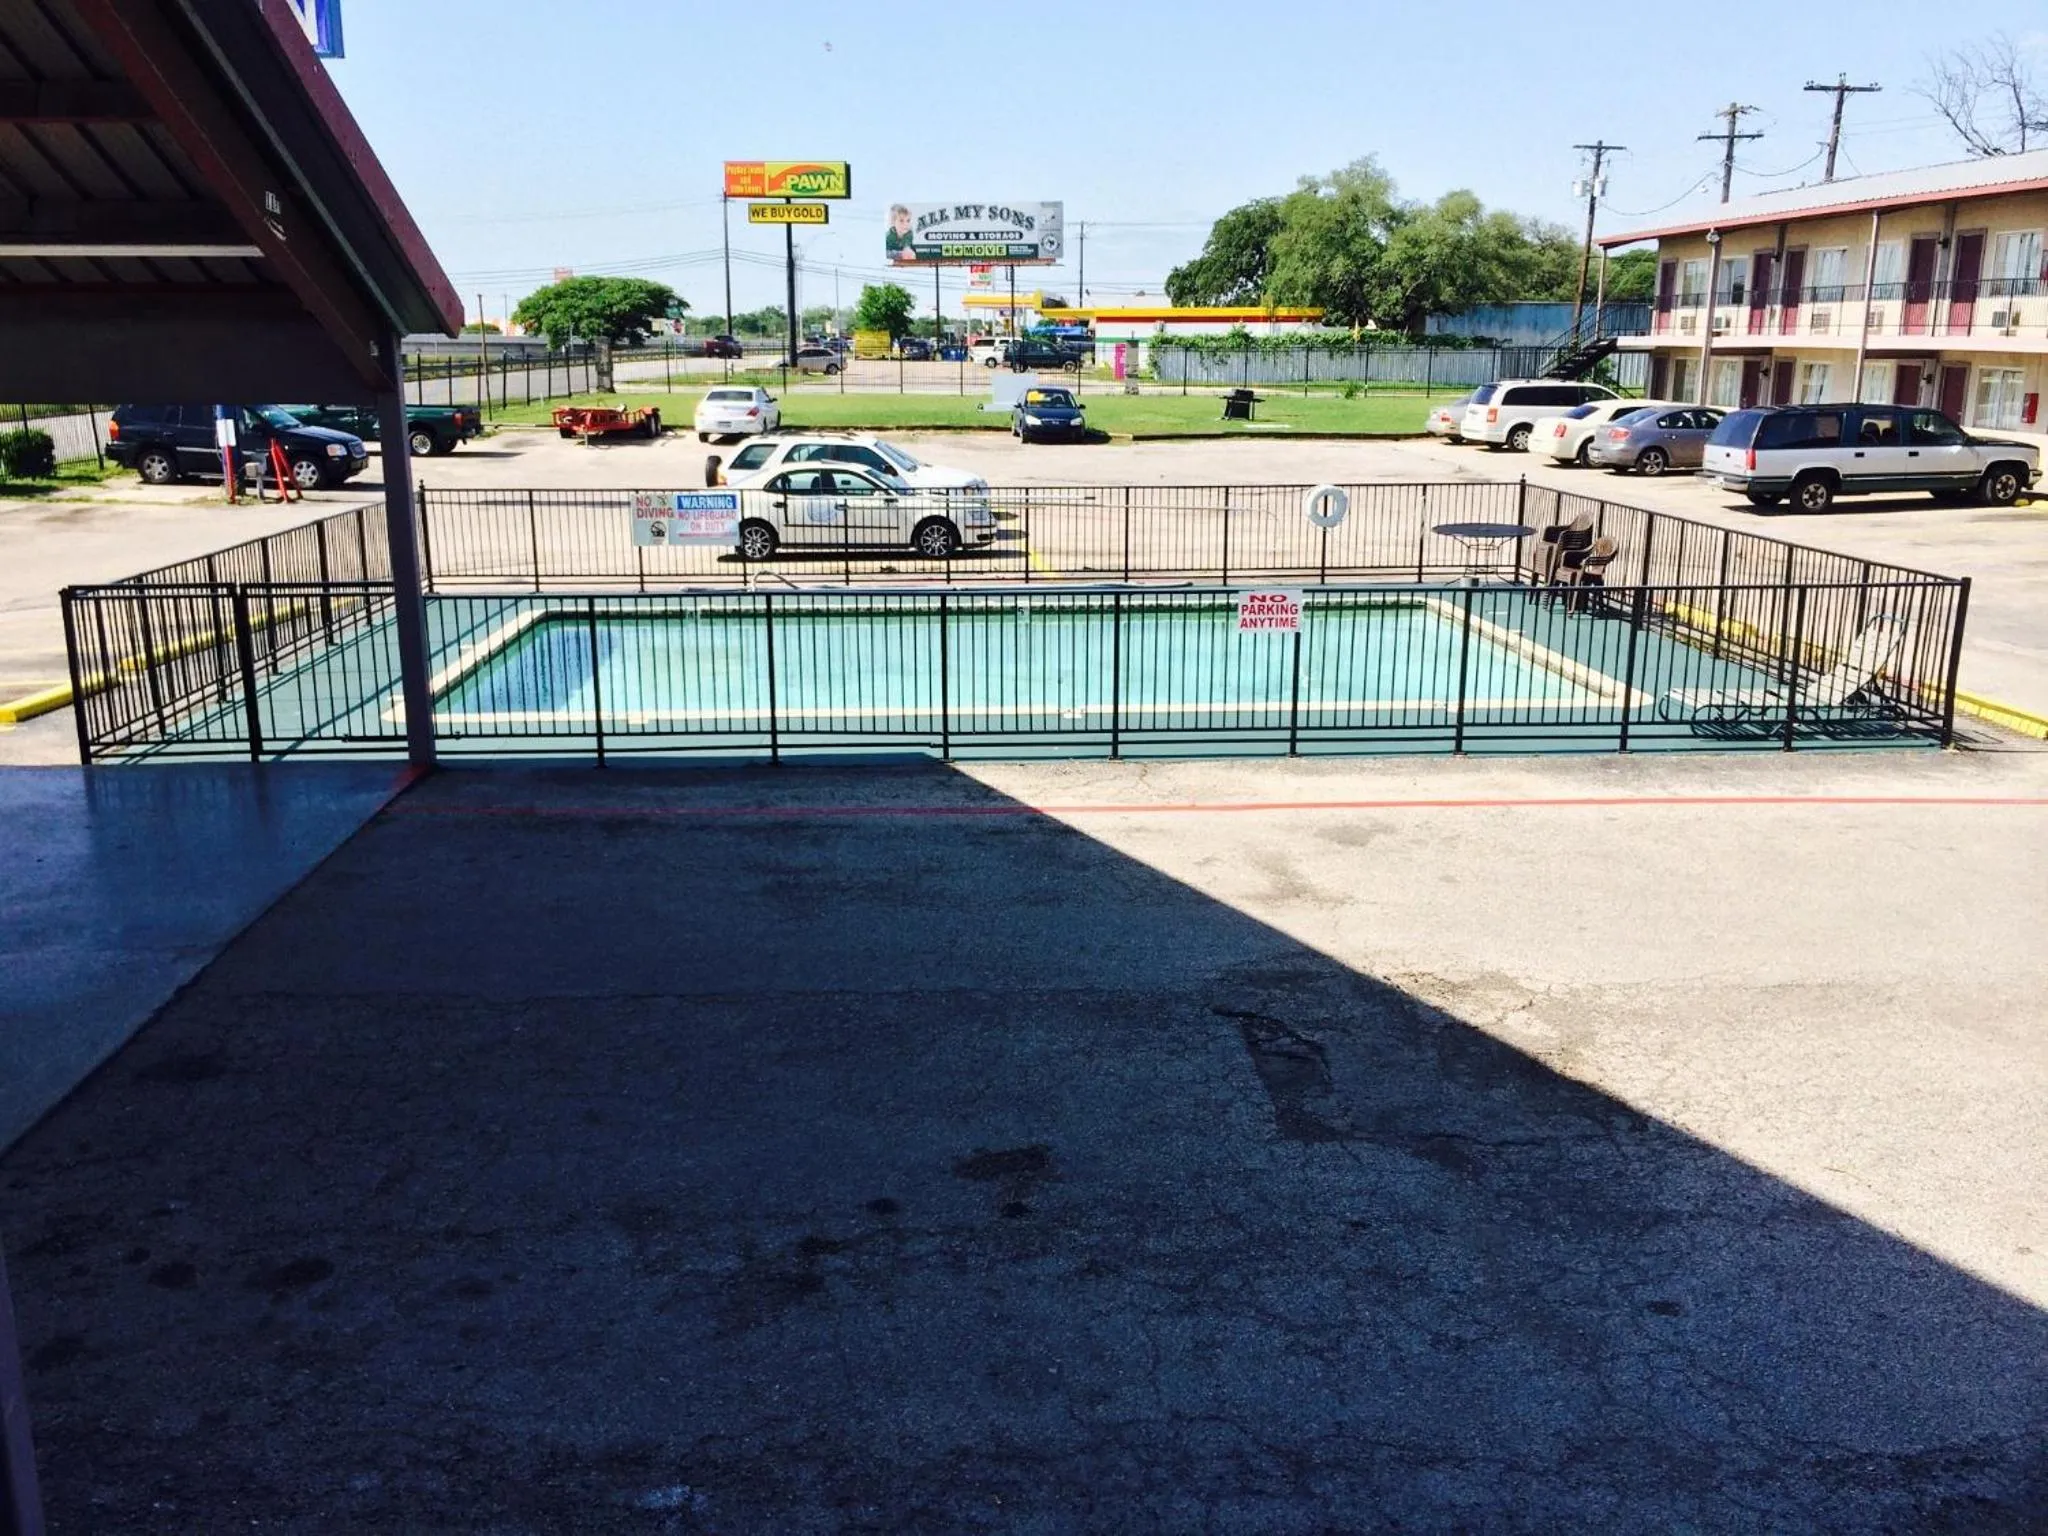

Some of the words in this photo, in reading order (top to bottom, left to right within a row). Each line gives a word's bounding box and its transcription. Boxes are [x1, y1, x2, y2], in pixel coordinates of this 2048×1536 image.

[786, 174, 845, 191] PAWN
[751, 207, 768, 218] WE
[916, 208, 950, 232] ALL
[954, 204, 985, 220] MY
[988, 205, 1035, 231] SONS
[928, 232, 966, 240] MOVING
[969, 232, 977, 240] &
[979, 232, 1021, 240] STORAGE
[636, 496, 652, 507] NO
[680, 496, 734, 509] WARNING
[636, 508, 674, 519] DIVING
[677, 511, 690, 520] NO
[693, 511, 737, 520] LIFEGUARD
[690, 521, 702, 530] ON
[705, 521, 725, 530] DUTY
[1249, 594, 1287, 603] NO
[1241, 604, 1298, 615] PARKING
[1240, 617, 1297, 628] ANYTIME
